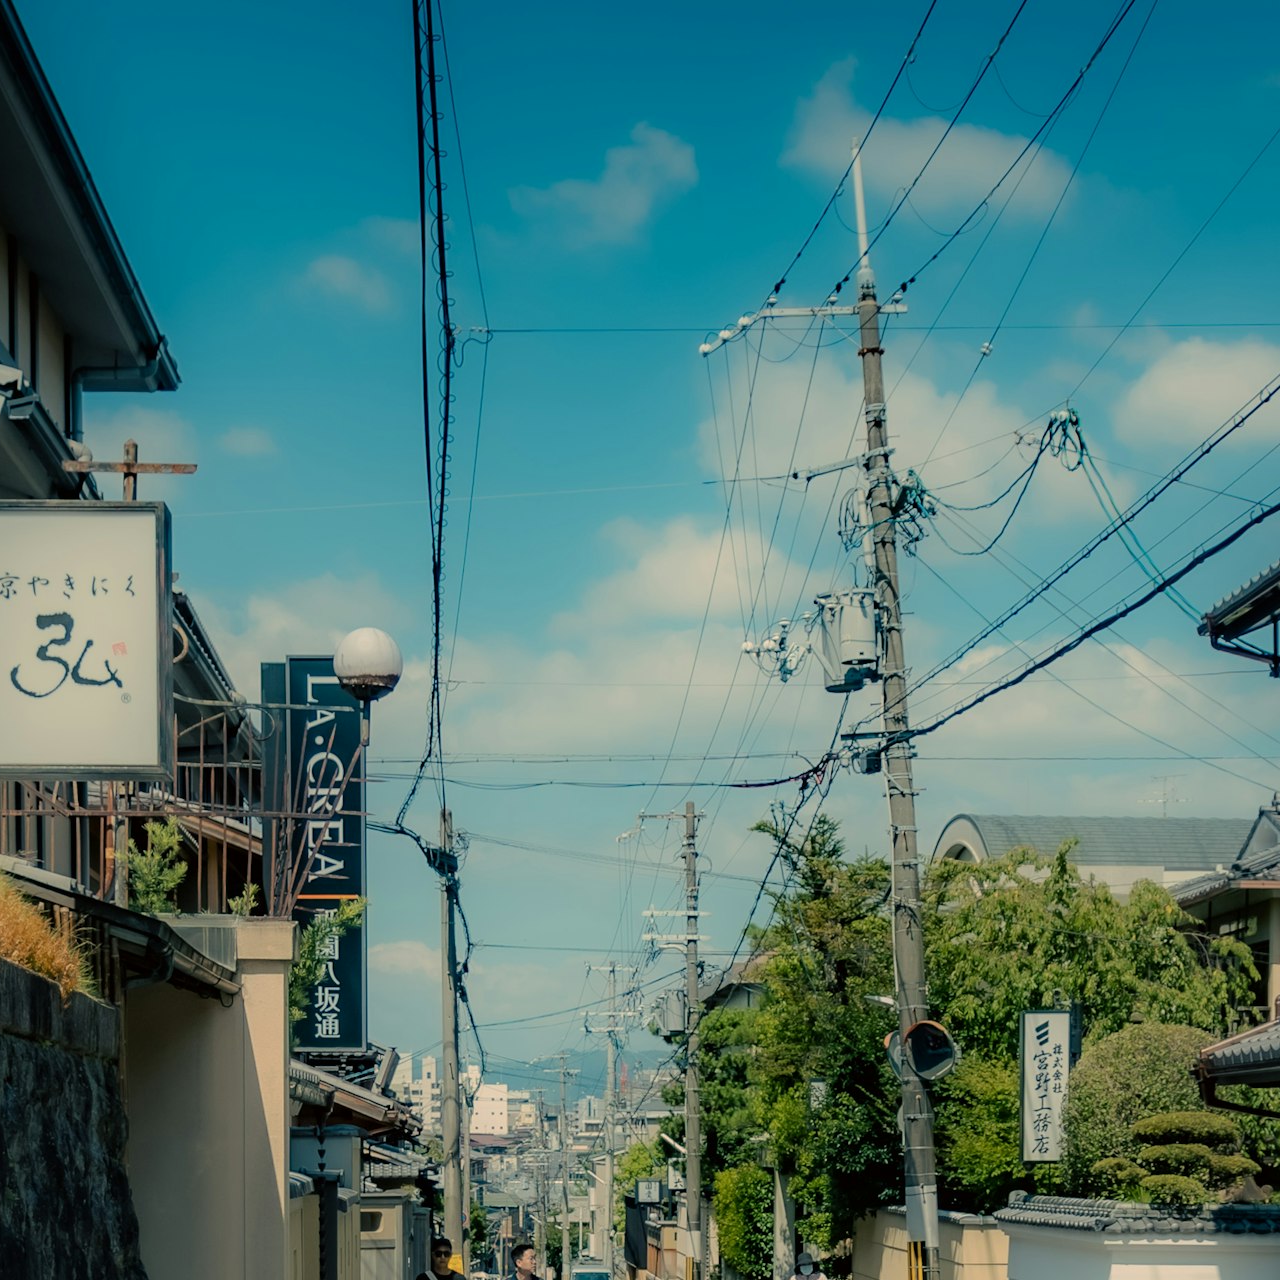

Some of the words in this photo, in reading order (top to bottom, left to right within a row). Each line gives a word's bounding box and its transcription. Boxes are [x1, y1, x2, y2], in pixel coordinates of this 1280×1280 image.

[10, 611, 124, 699] 弘
[1031, 1050, 1053, 1154] 宮野工務店
[1051, 1043, 1065, 1094] 株式会社
